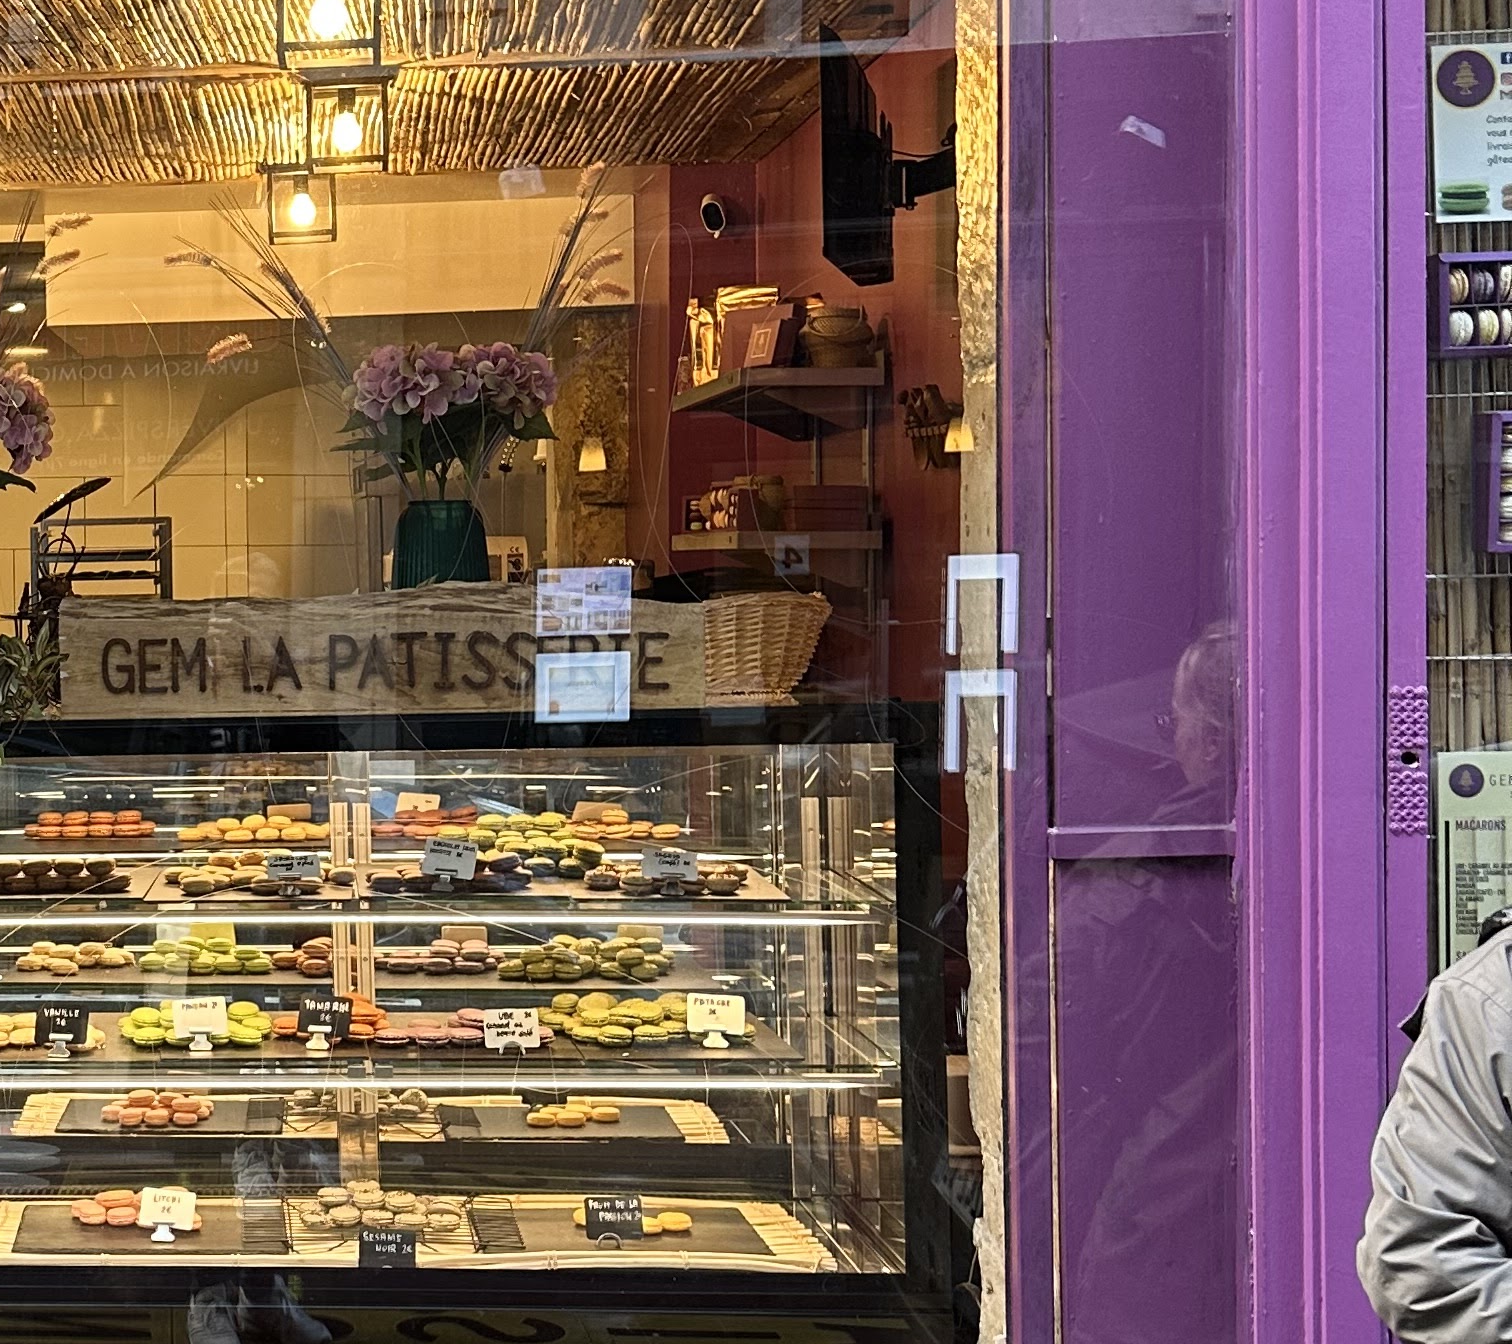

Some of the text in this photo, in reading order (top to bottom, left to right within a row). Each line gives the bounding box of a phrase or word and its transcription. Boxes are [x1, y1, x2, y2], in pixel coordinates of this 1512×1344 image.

[101, 636, 208, 695] GEM
[241, 635, 302, 693] LA
[1455, 817, 1506, 832] MACARONS
